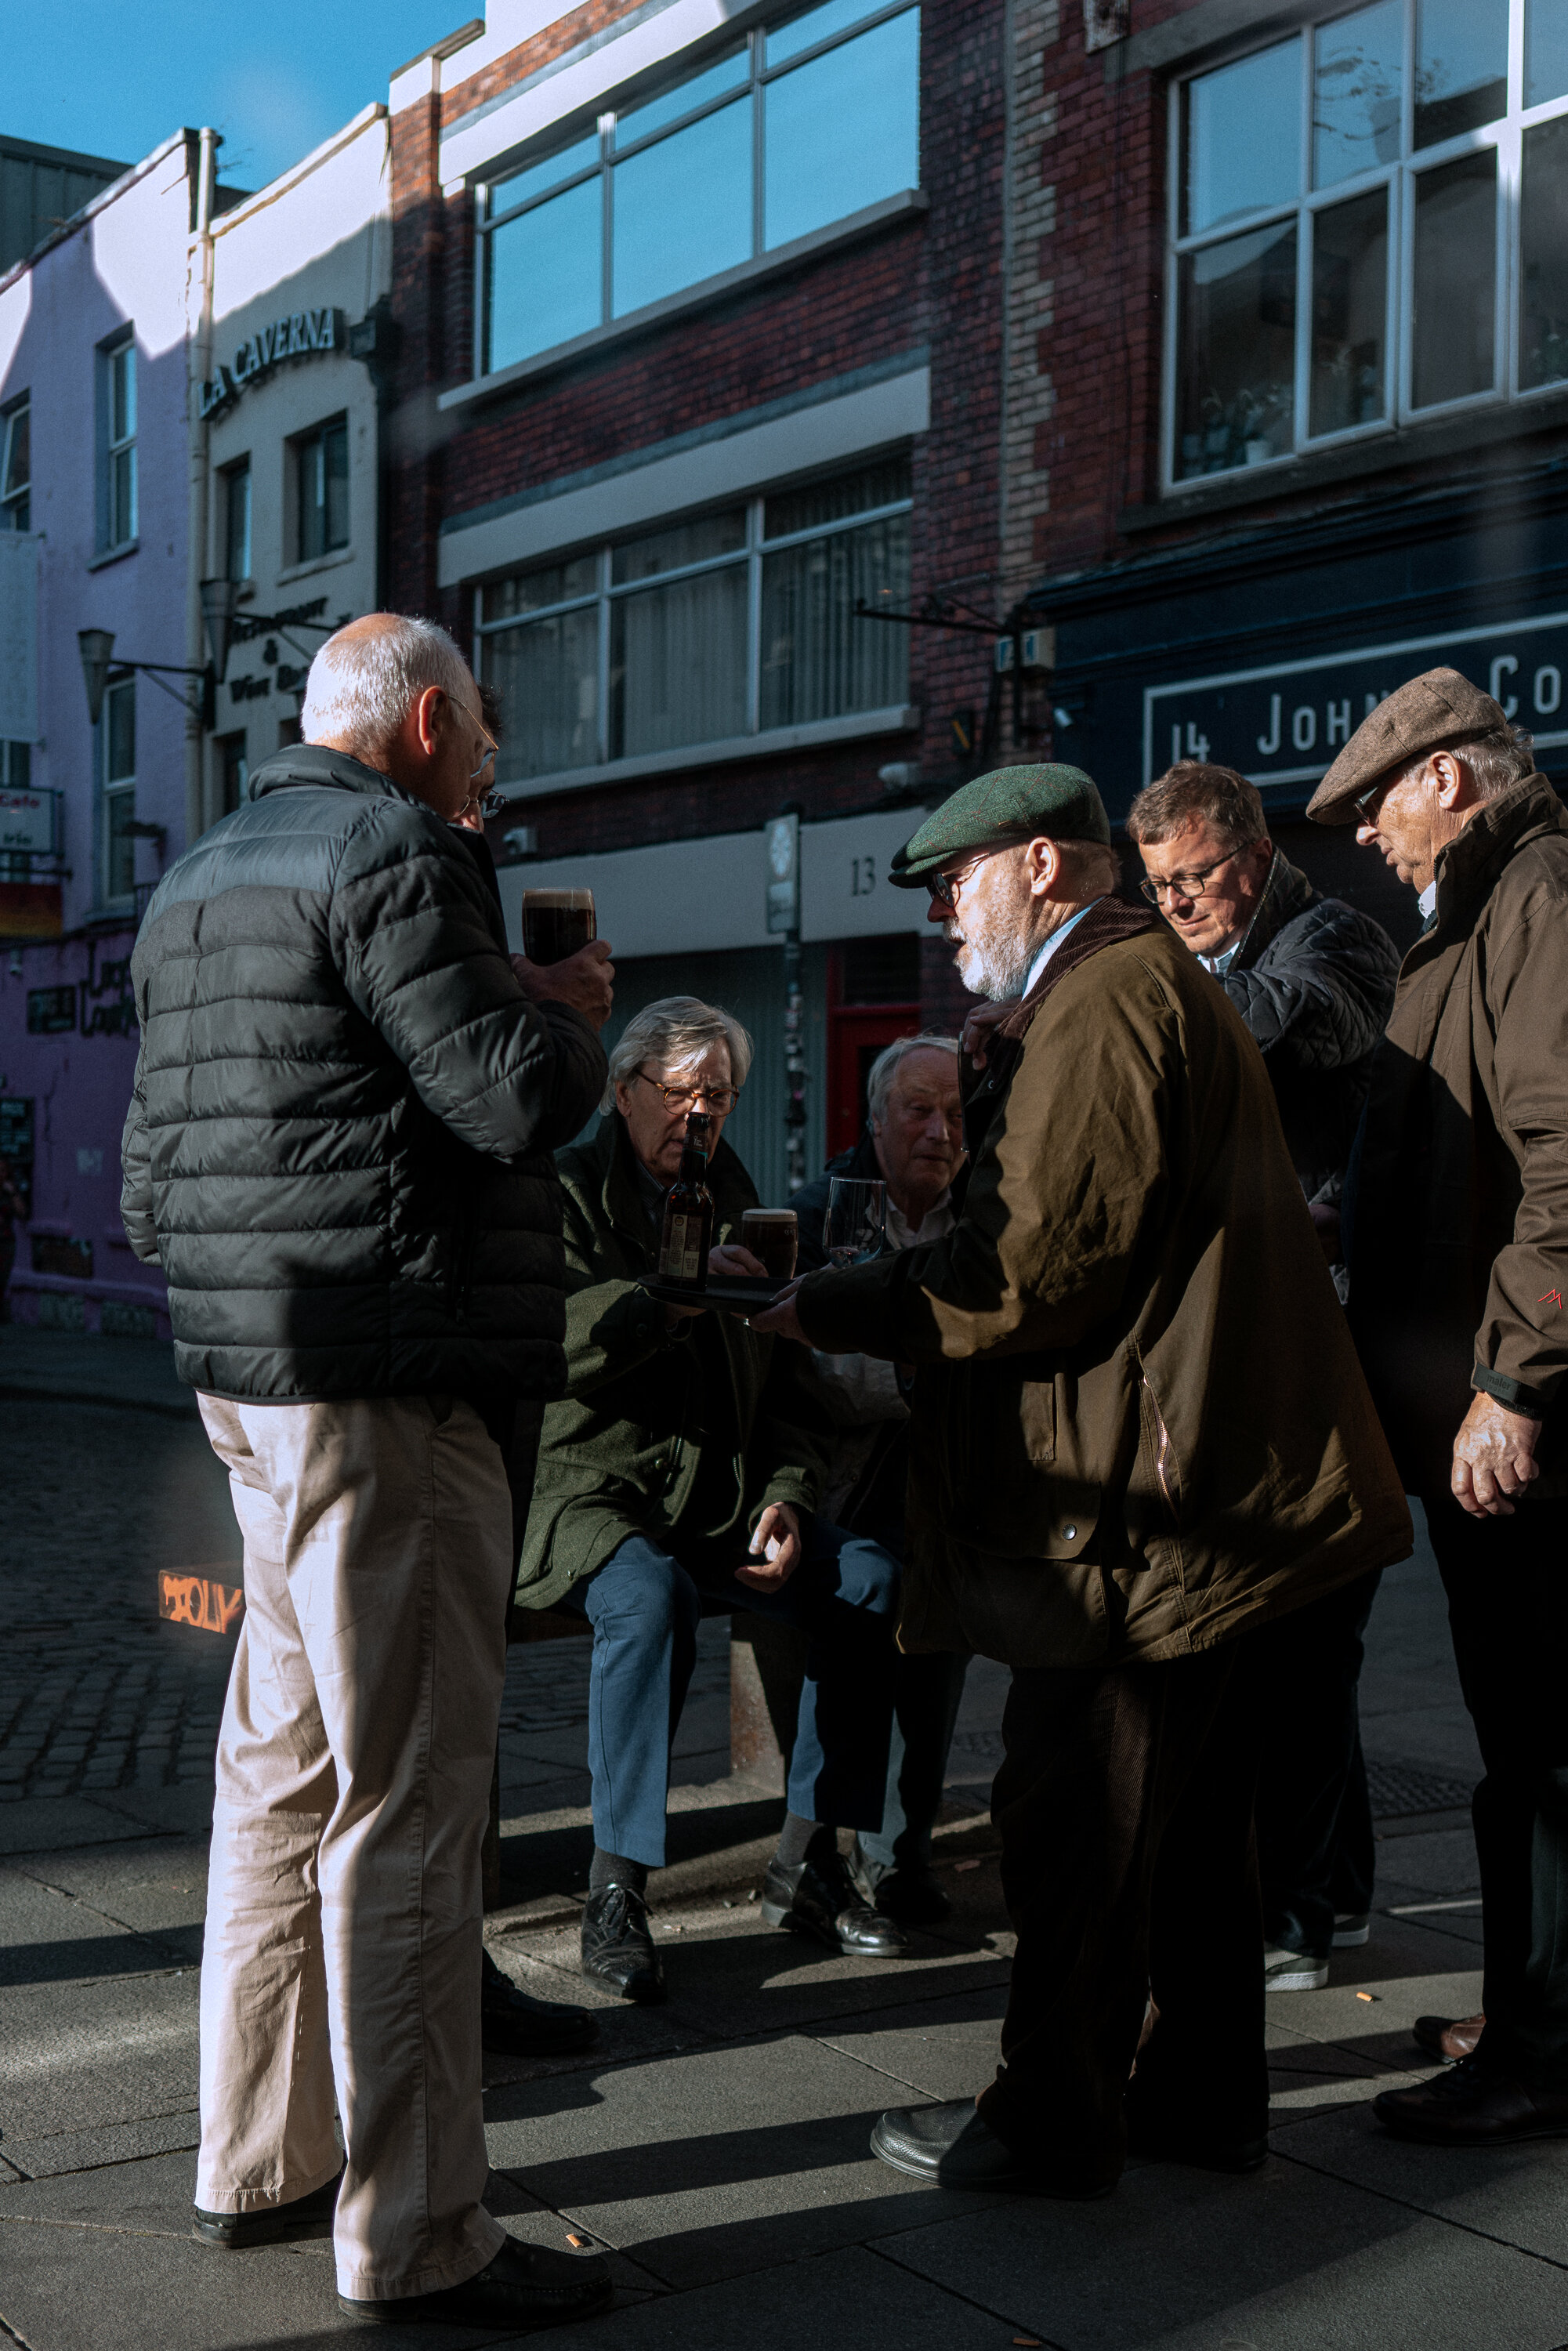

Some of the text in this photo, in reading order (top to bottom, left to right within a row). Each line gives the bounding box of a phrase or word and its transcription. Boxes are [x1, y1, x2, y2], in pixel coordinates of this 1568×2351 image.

[197, 308, 335, 418] LA CAVERNA
[1171, 719, 1211, 764] 14
[851, 857, 877, 897] 13
